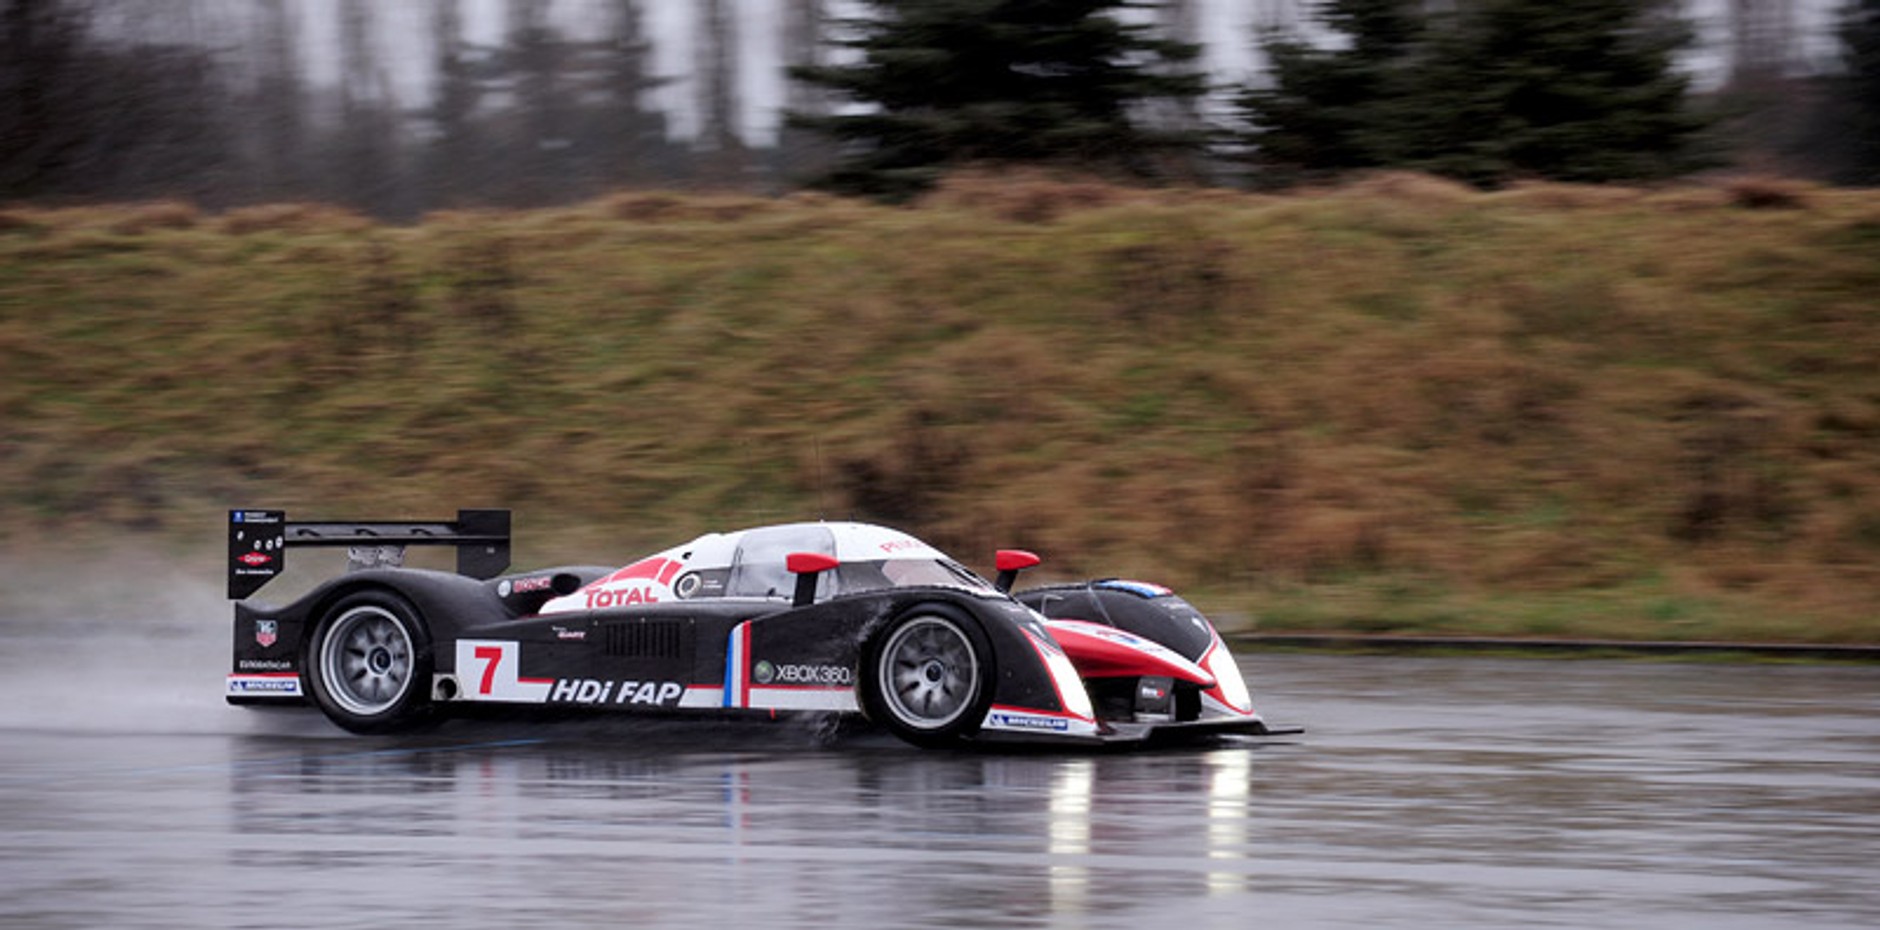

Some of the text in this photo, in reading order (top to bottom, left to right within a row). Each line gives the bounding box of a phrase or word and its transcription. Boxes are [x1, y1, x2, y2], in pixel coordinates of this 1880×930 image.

[585, 587, 659, 609] TOTAL
[474, 646, 503, 695] 7
[552, 679, 682, 706] HDi FAP
